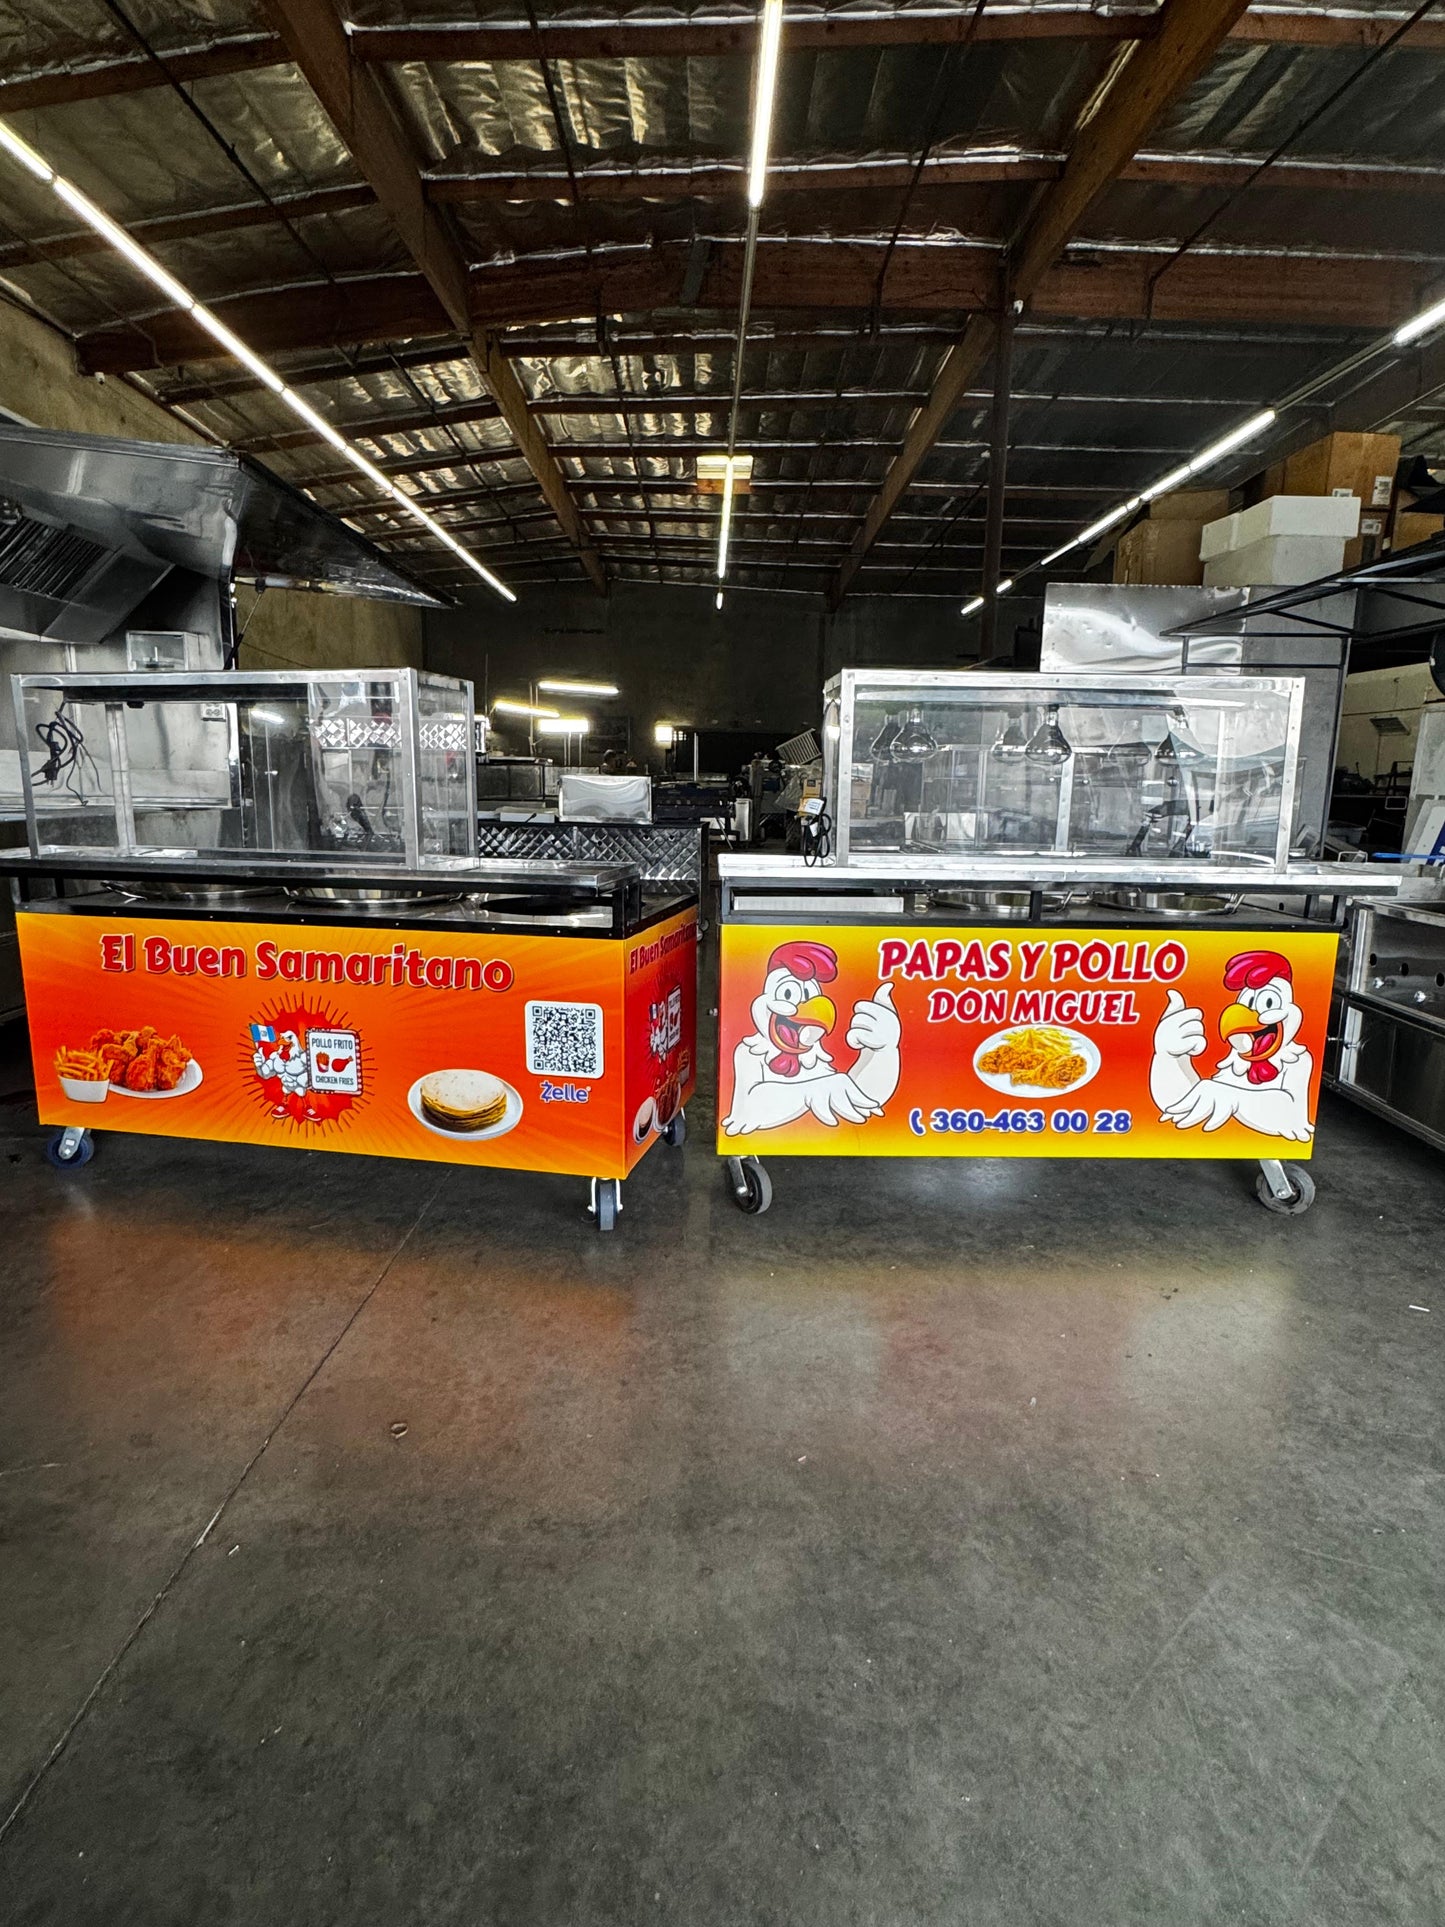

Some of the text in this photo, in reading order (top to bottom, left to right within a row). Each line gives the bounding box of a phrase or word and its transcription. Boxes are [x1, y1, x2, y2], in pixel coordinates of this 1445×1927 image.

[100, 933, 515, 992] El Buen Samaritano
[878, 938, 1187, 983] PAPAS Y POLLO
[927, 987, 1140, 1024] DON MIGUEL
[311, 1037, 353, 1050] POLLO FRITO
[315, 1075, 354, 1085] CHICKEN FRIES
[540, 1080, 589, 1103] Zelle
[930, 1109, 1132, 1133] 360-463 00 28
